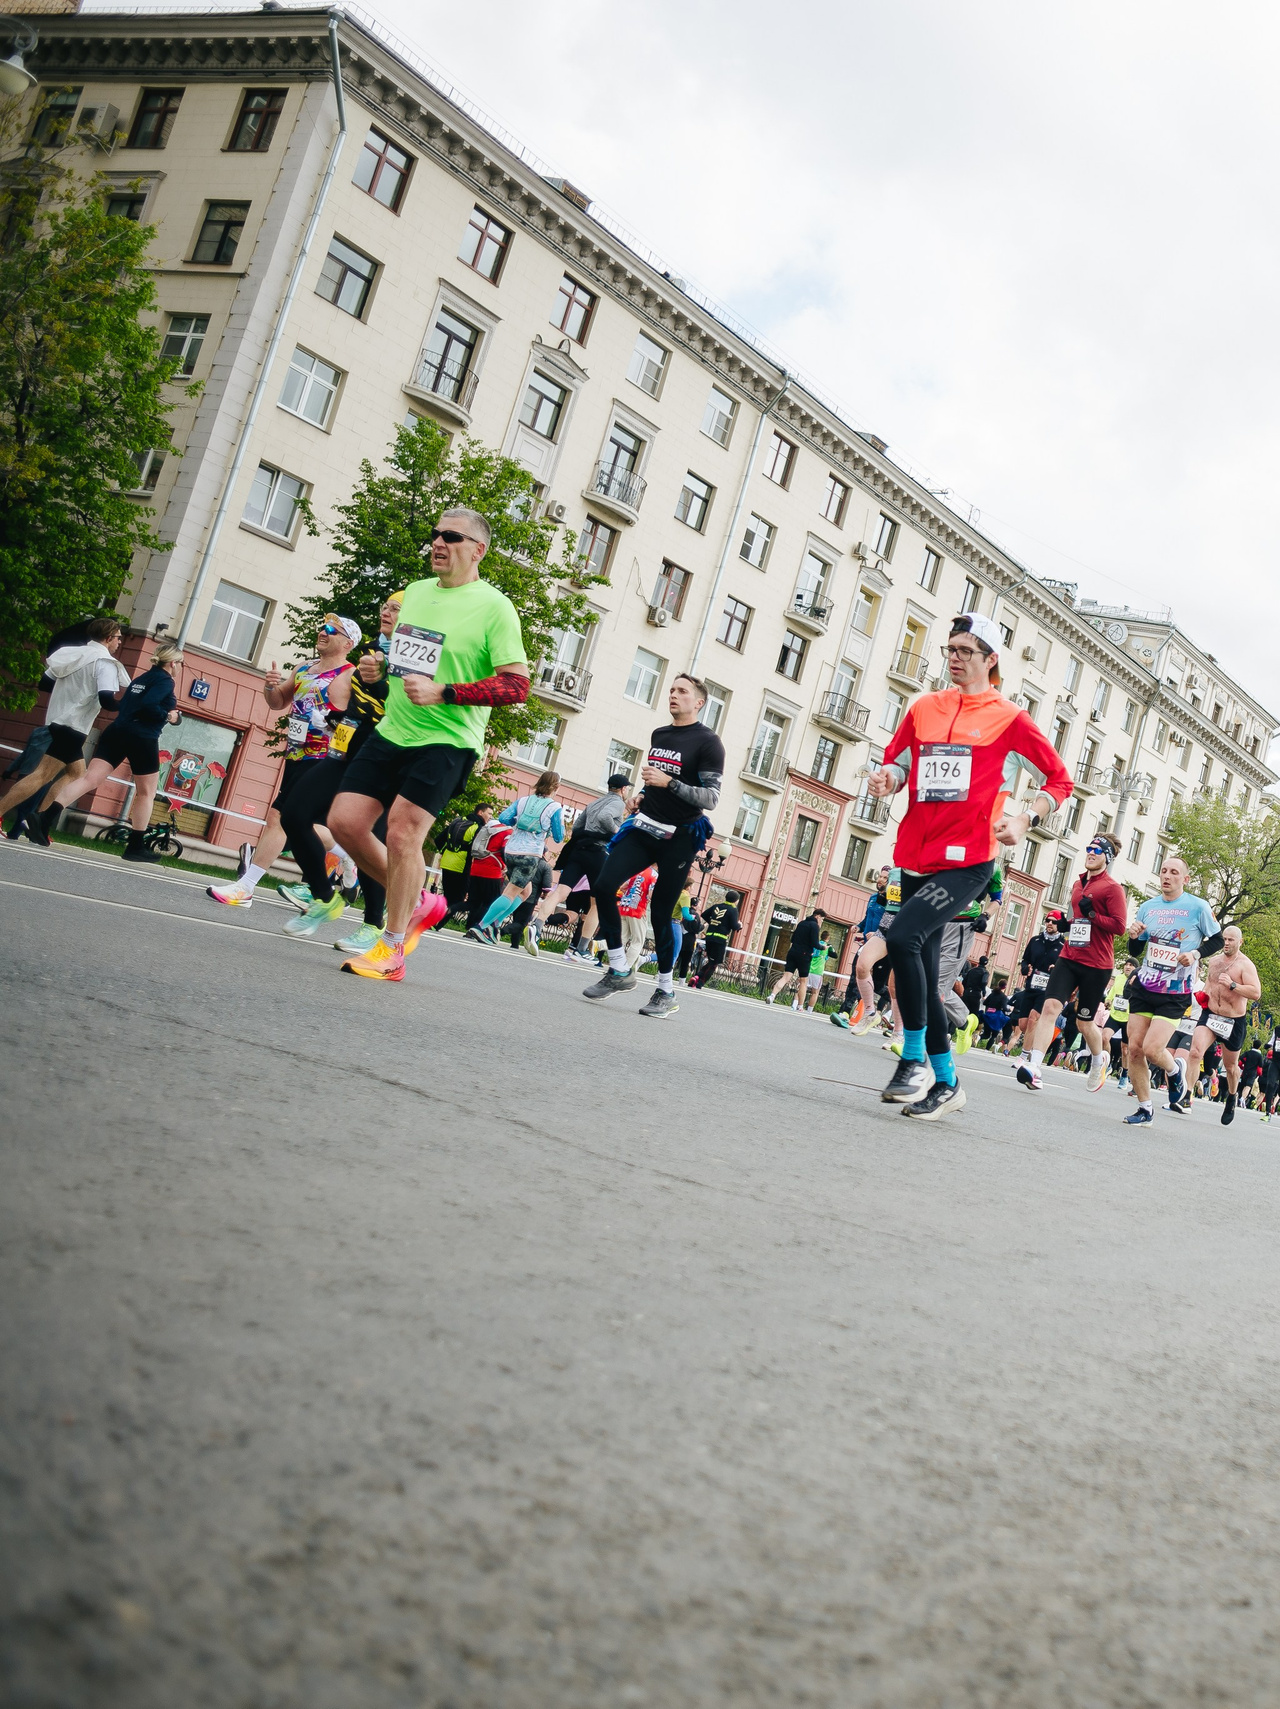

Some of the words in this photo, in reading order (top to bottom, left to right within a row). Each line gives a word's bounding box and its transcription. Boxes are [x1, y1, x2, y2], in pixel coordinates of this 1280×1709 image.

[395, 638, 437, 664] 12726
[194, 684, 208, 696] 34
[649, 747, 682, 762] ГОНКА
[181, 758, 196, 771] 80
[925, 761, 961, 779] 2196
[773, 910, 799, 925] КОВРЫ
[1158, 917, 1175, 925] RUN
[1150, 947, 1177, 962] 18972
[1211, 1021, 1229, 1032] 4706
